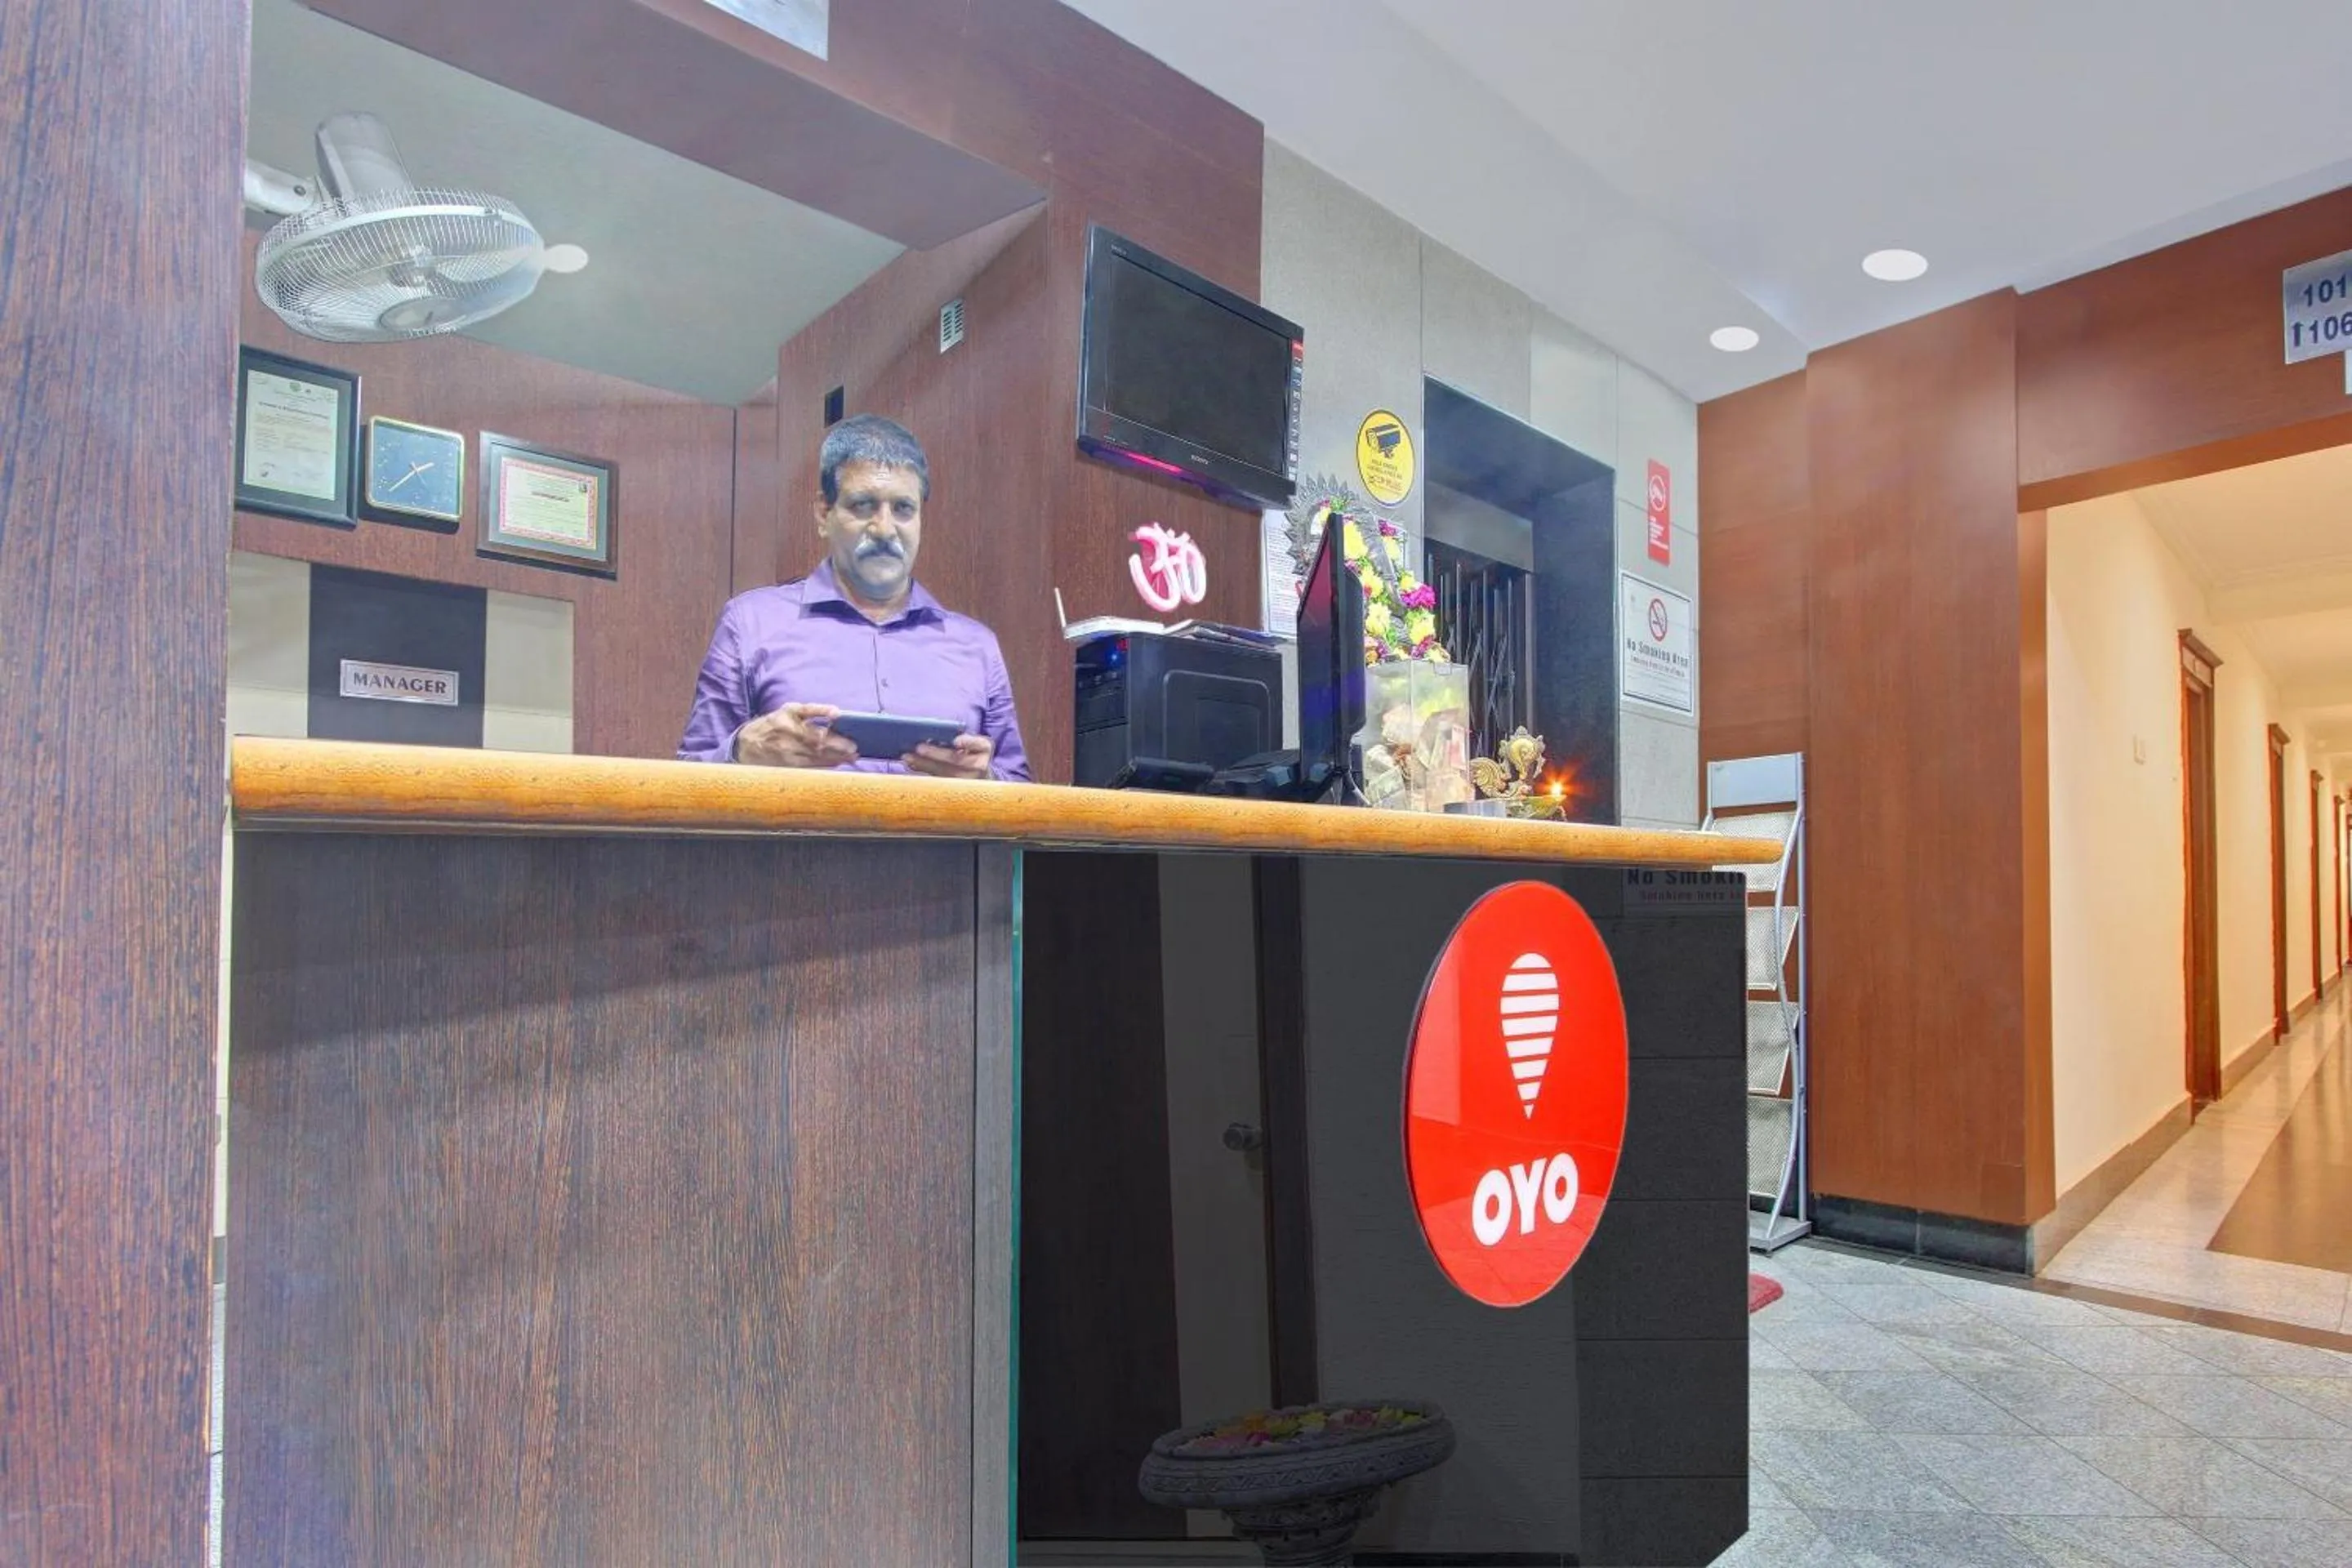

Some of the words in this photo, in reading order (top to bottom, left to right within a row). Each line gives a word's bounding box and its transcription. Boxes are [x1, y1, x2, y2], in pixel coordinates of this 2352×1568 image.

[2304, 274, 2346, 307] 101
[2309, 311, 2352, 344] 106
[354, 672, 447, 693] MANAGER
[1472, 1152, 1579, 1246] OYO
